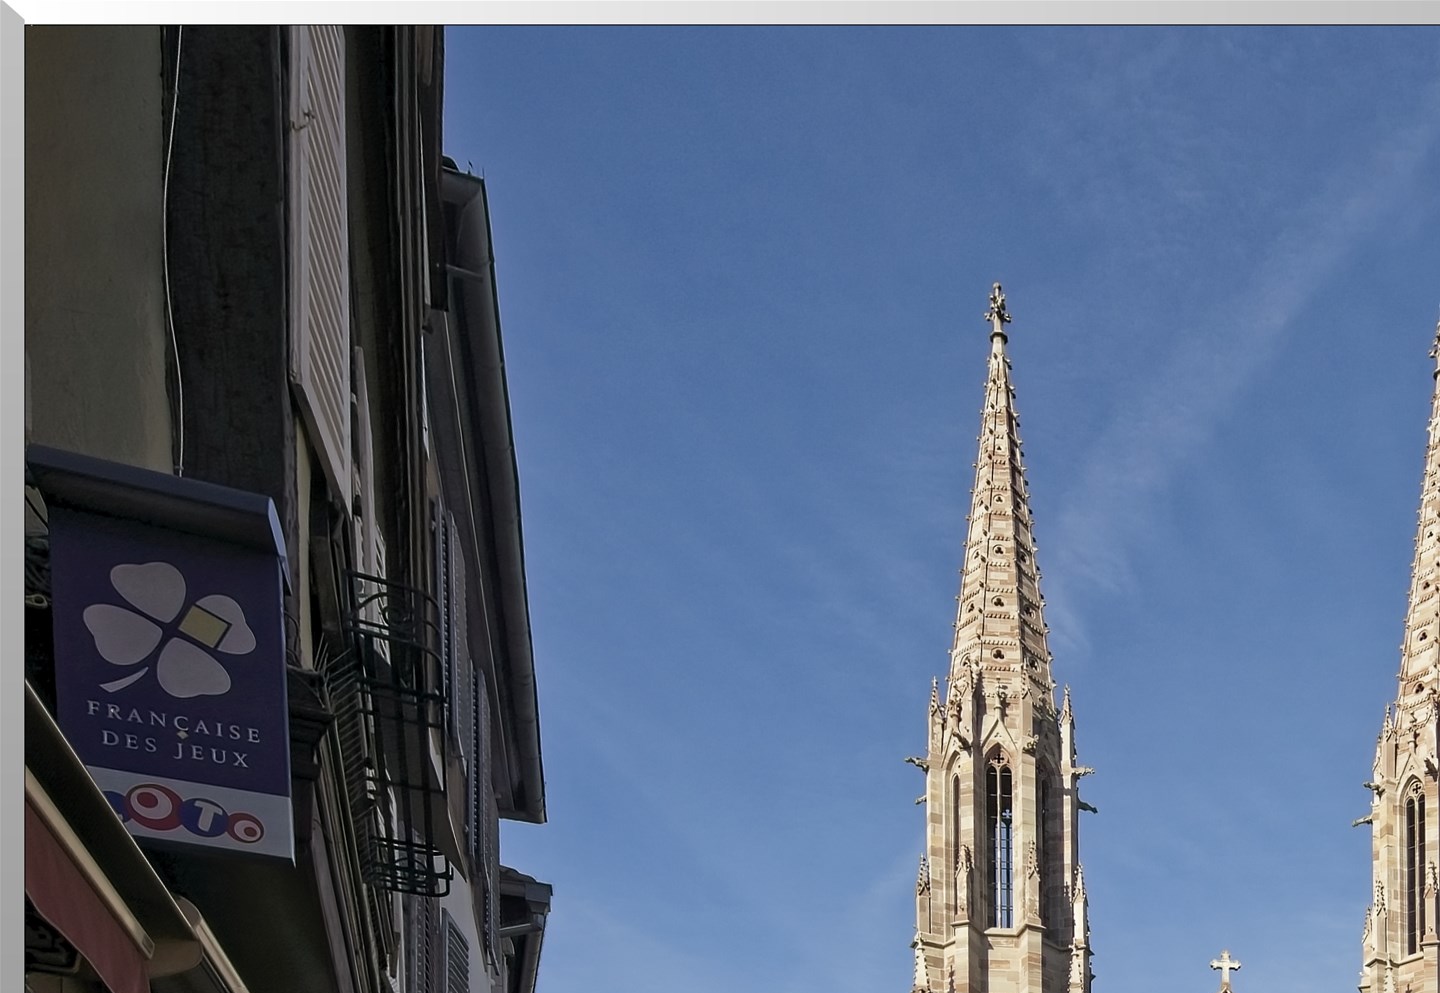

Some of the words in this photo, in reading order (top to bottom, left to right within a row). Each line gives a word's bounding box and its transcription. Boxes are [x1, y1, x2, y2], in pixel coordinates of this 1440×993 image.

[102, 730, 158, 753] DES
[173, 743, 250, 768] JEUX
[116, 786, 262, 843] OTO
